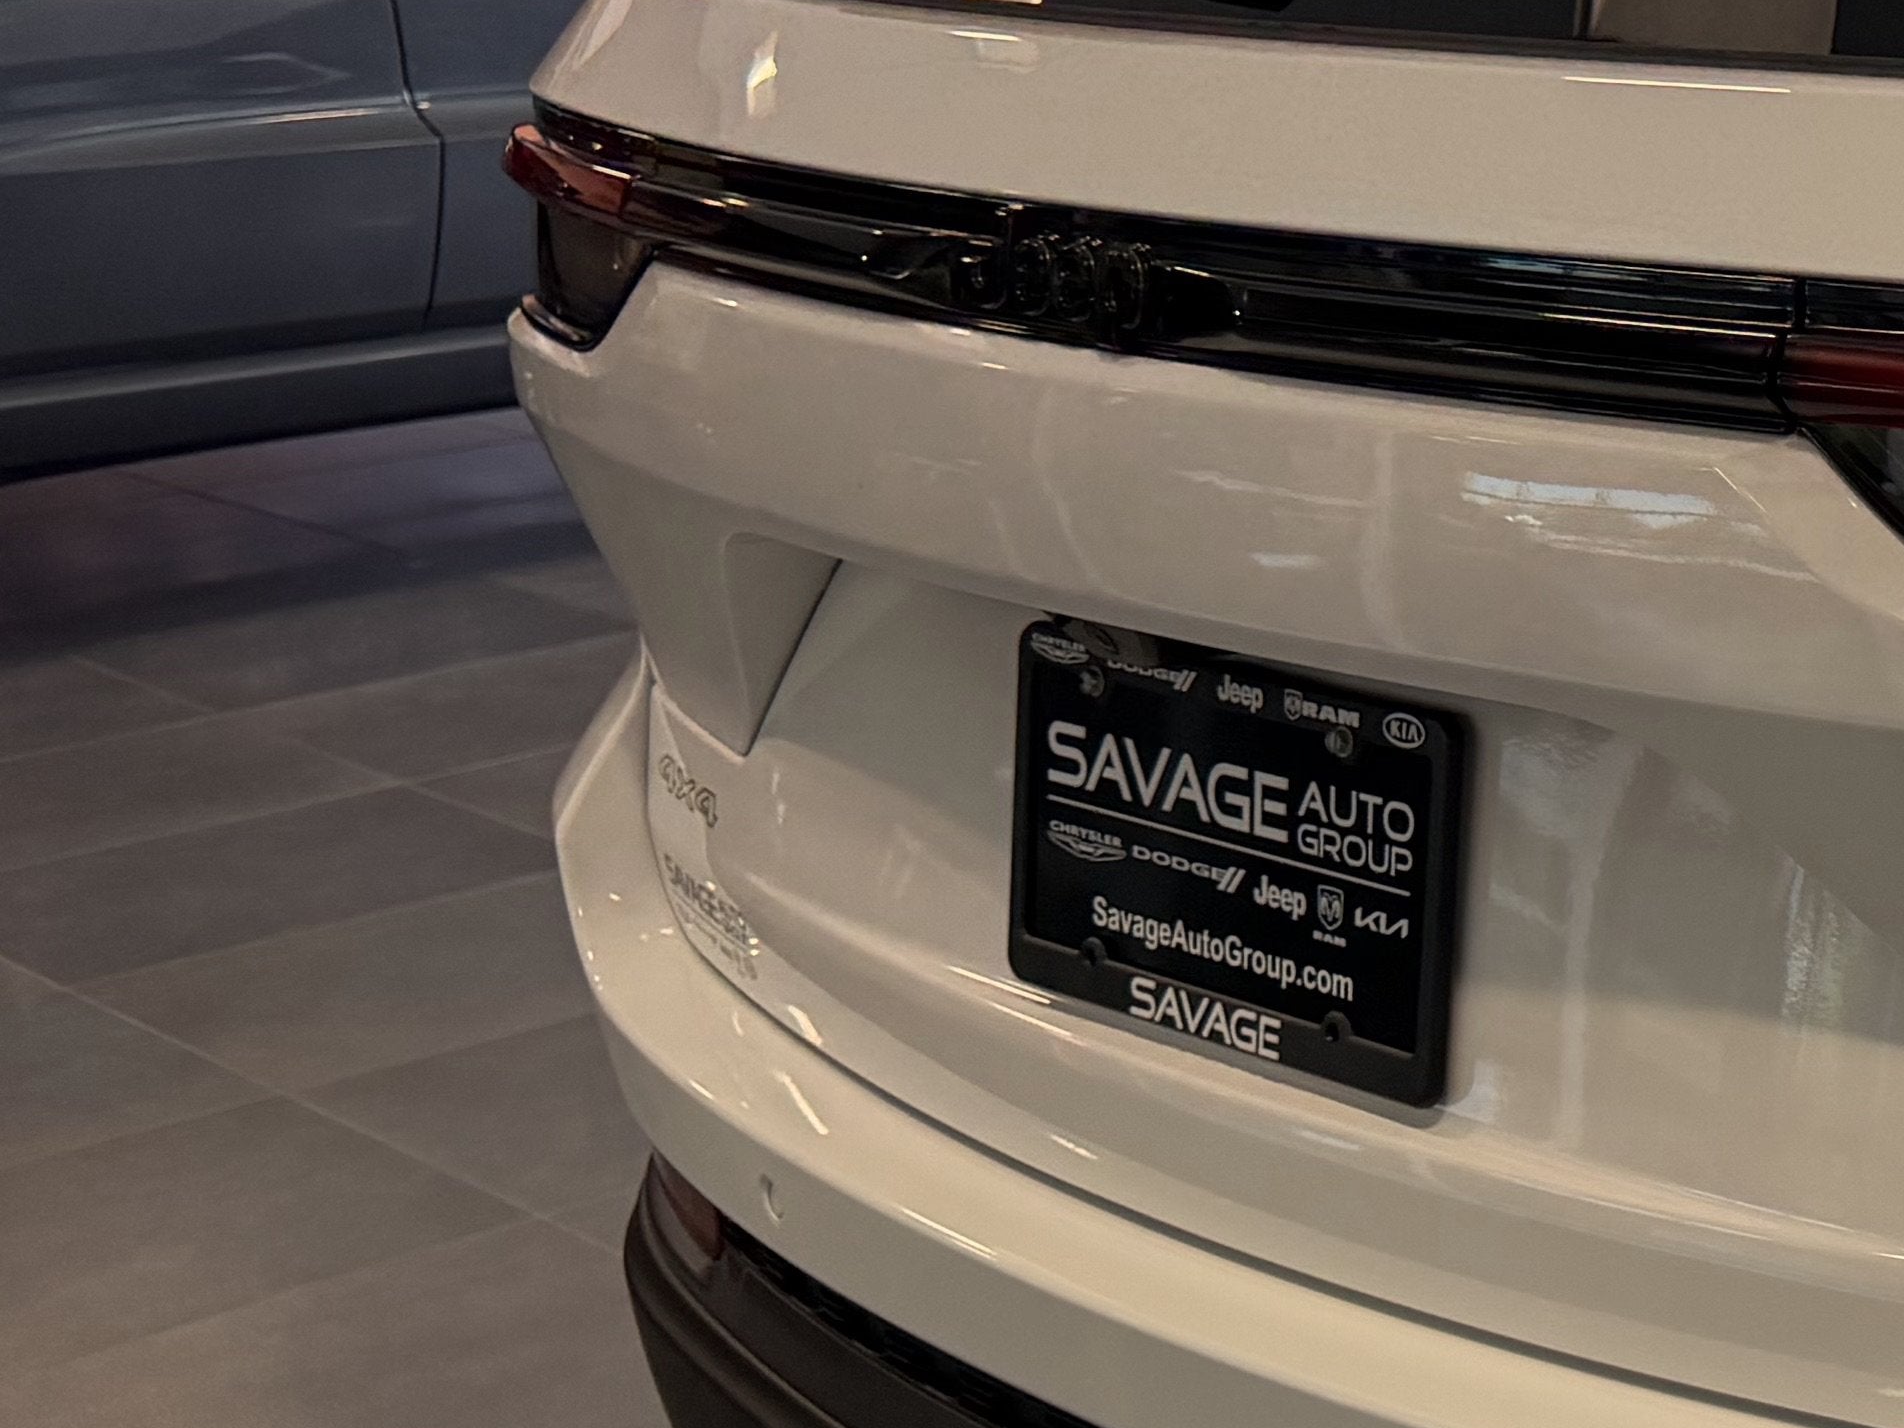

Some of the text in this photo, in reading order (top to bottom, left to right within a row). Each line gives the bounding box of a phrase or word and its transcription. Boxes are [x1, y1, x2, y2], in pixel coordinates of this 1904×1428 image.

[1217, 674, 1264, 714] Jeep
[1302, 700, 1360, 728] RAM
[1389, 719, 1421, 742] KIA
[1047, 720, 1416, 844] SAVAGE AUTO
[1050, 819, 1122, 848] CHRYSLER
[1132, 845, 1228, 884] DODGE
[1253, 874, 1307, 921] Jeep
[1297, 822, 1414, 876] GROUP
[1092, 895, 1355, 1002] SavageAutoGroup.com
[1130, 976, 1283, 1061] SAVAGE
